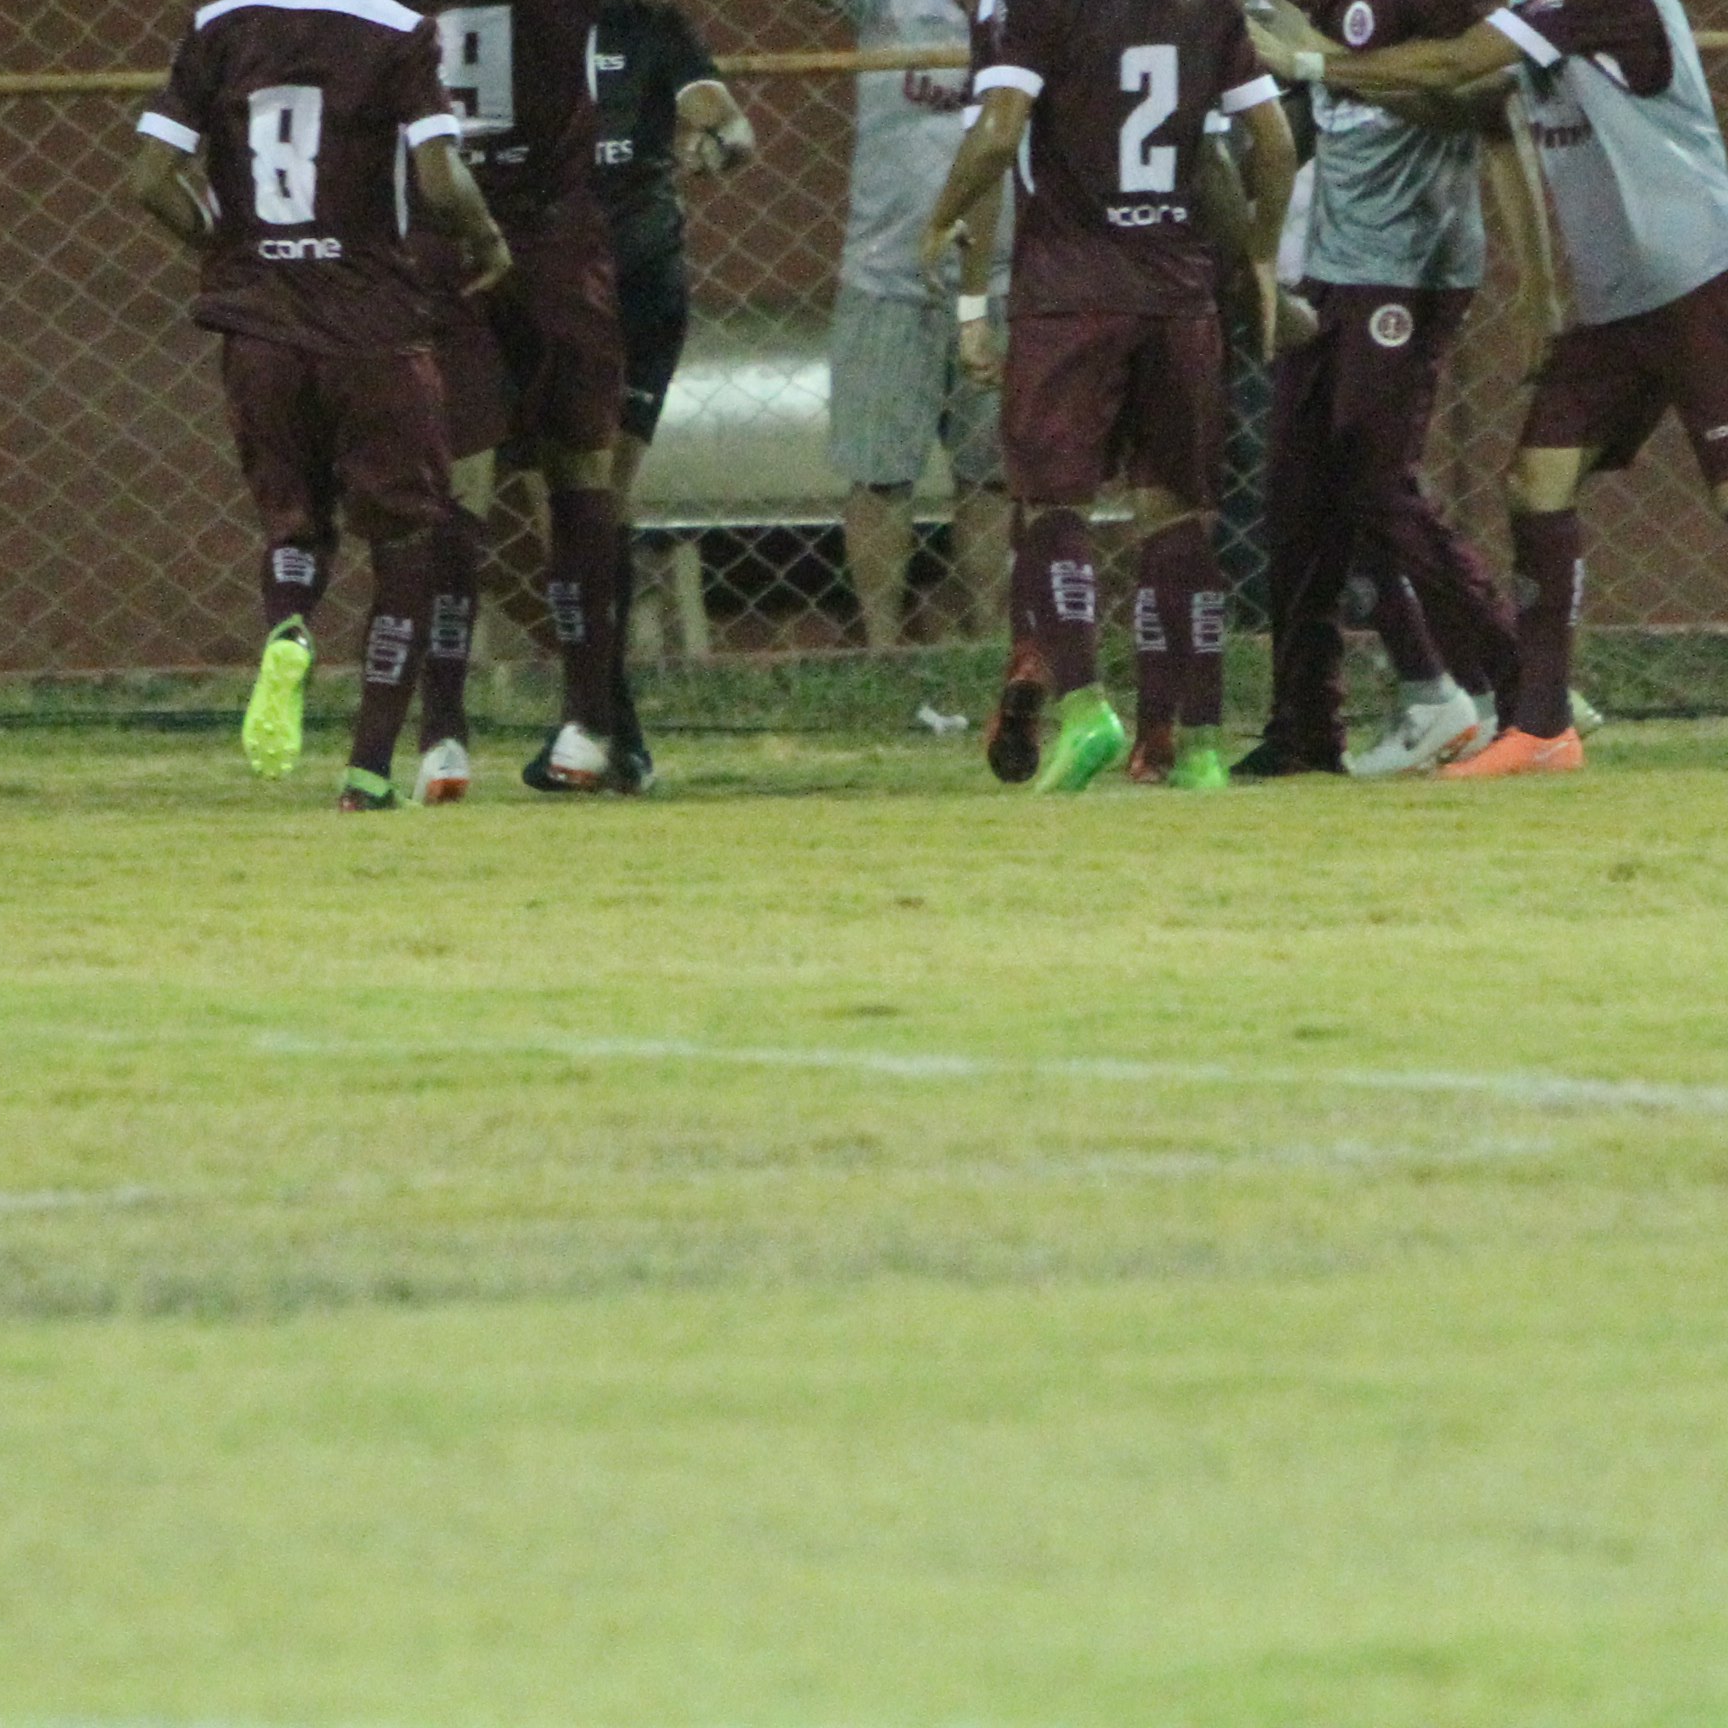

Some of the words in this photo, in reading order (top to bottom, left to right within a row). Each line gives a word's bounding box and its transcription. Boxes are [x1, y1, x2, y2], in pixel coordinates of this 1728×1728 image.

[436, 5, 515, 136] 9
[1119, 43, 1179, 193] 2
[247, 85, 324, 225] 8
